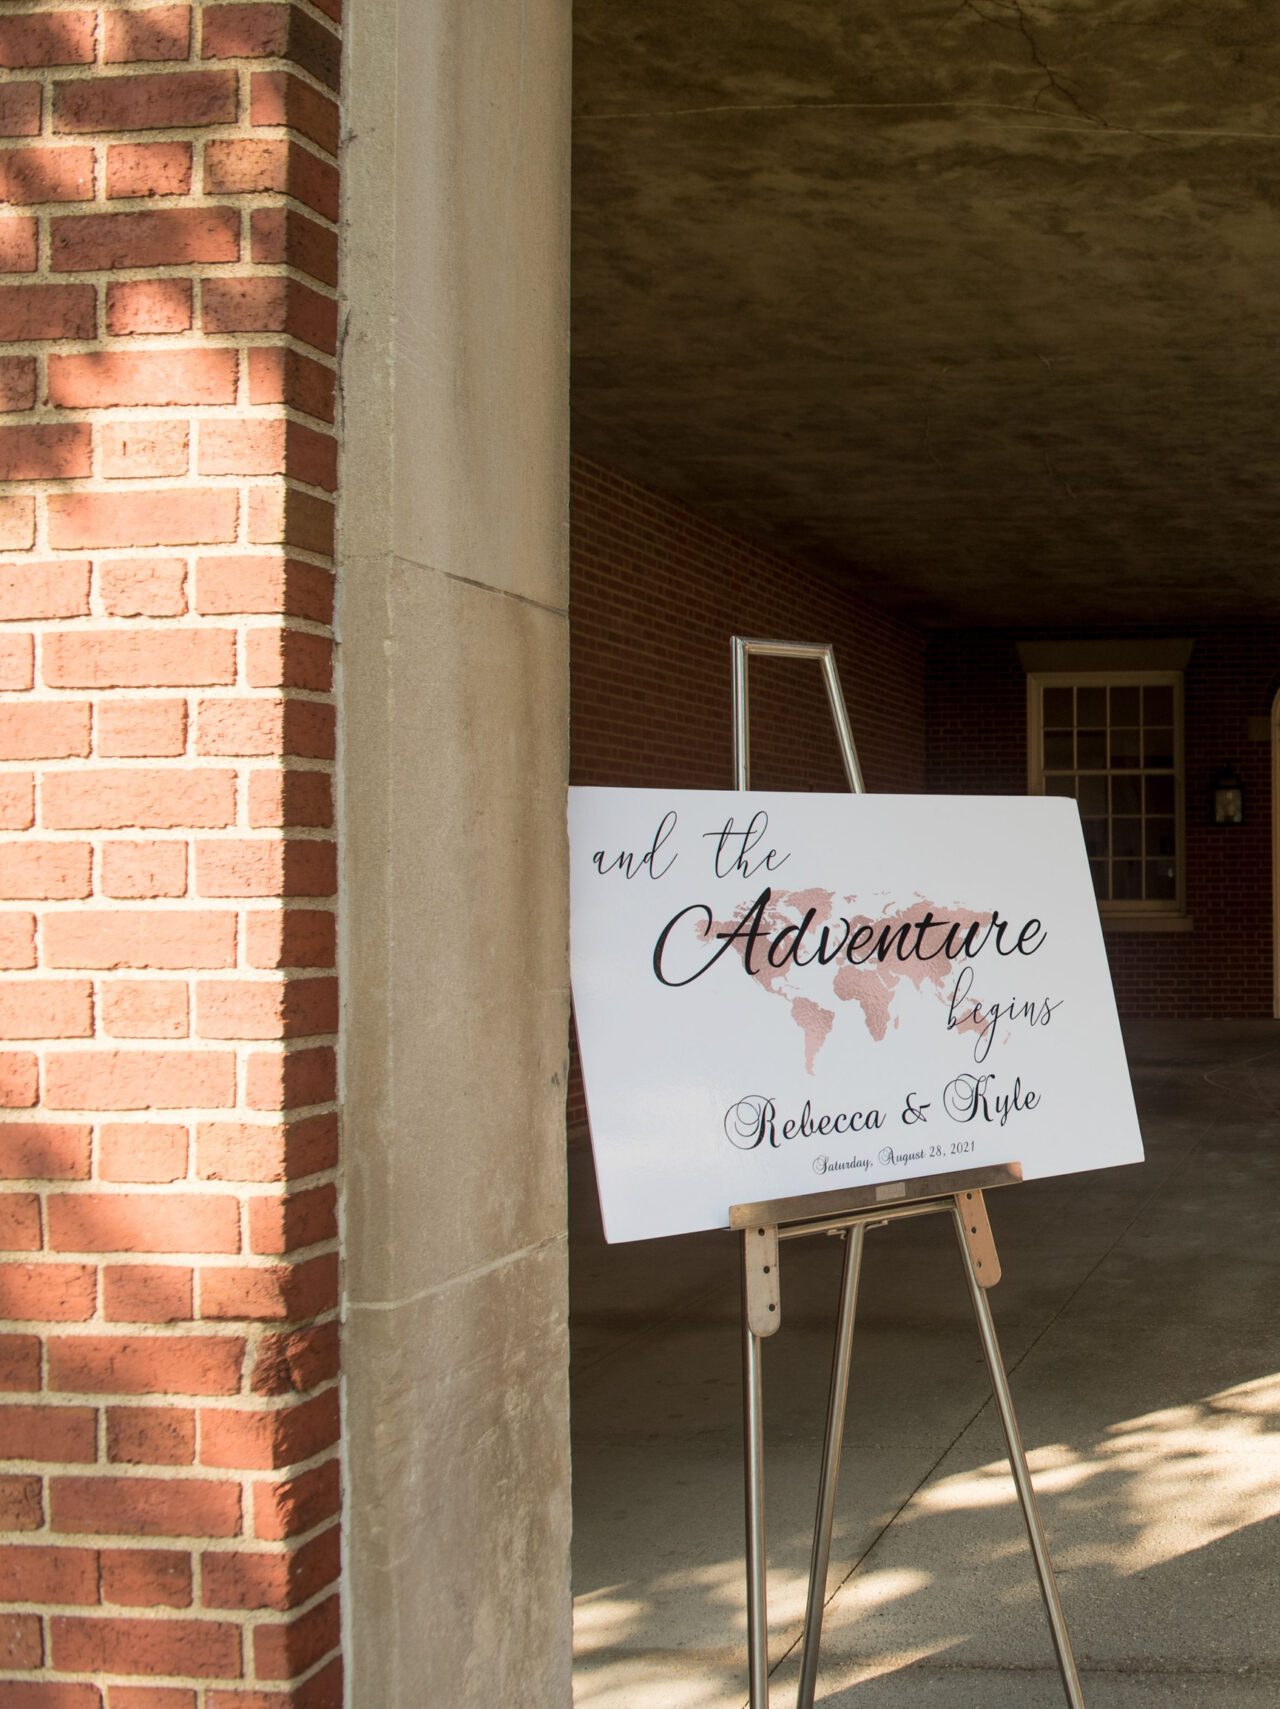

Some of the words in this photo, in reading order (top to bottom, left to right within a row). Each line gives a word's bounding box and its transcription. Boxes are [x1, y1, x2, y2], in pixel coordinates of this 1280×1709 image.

[592, 811, 678, 880] and
[702, 811, 791, 879] the
[652, 887, 1048, 987] Adventure
[946, 966, 1064, 1064] begins
[724, 1094, 886, 1150] Rebecca
[901, 1092, 931, 1125] &
[942, 1073, 1042, 1127] Kyle
[812, 1154, 873, 1175] Saturday,
[878, 1146, 925, 1166] August
[929, 1145, 947, 1159] 28,
[950, 1140, 975, 1155] 2021
